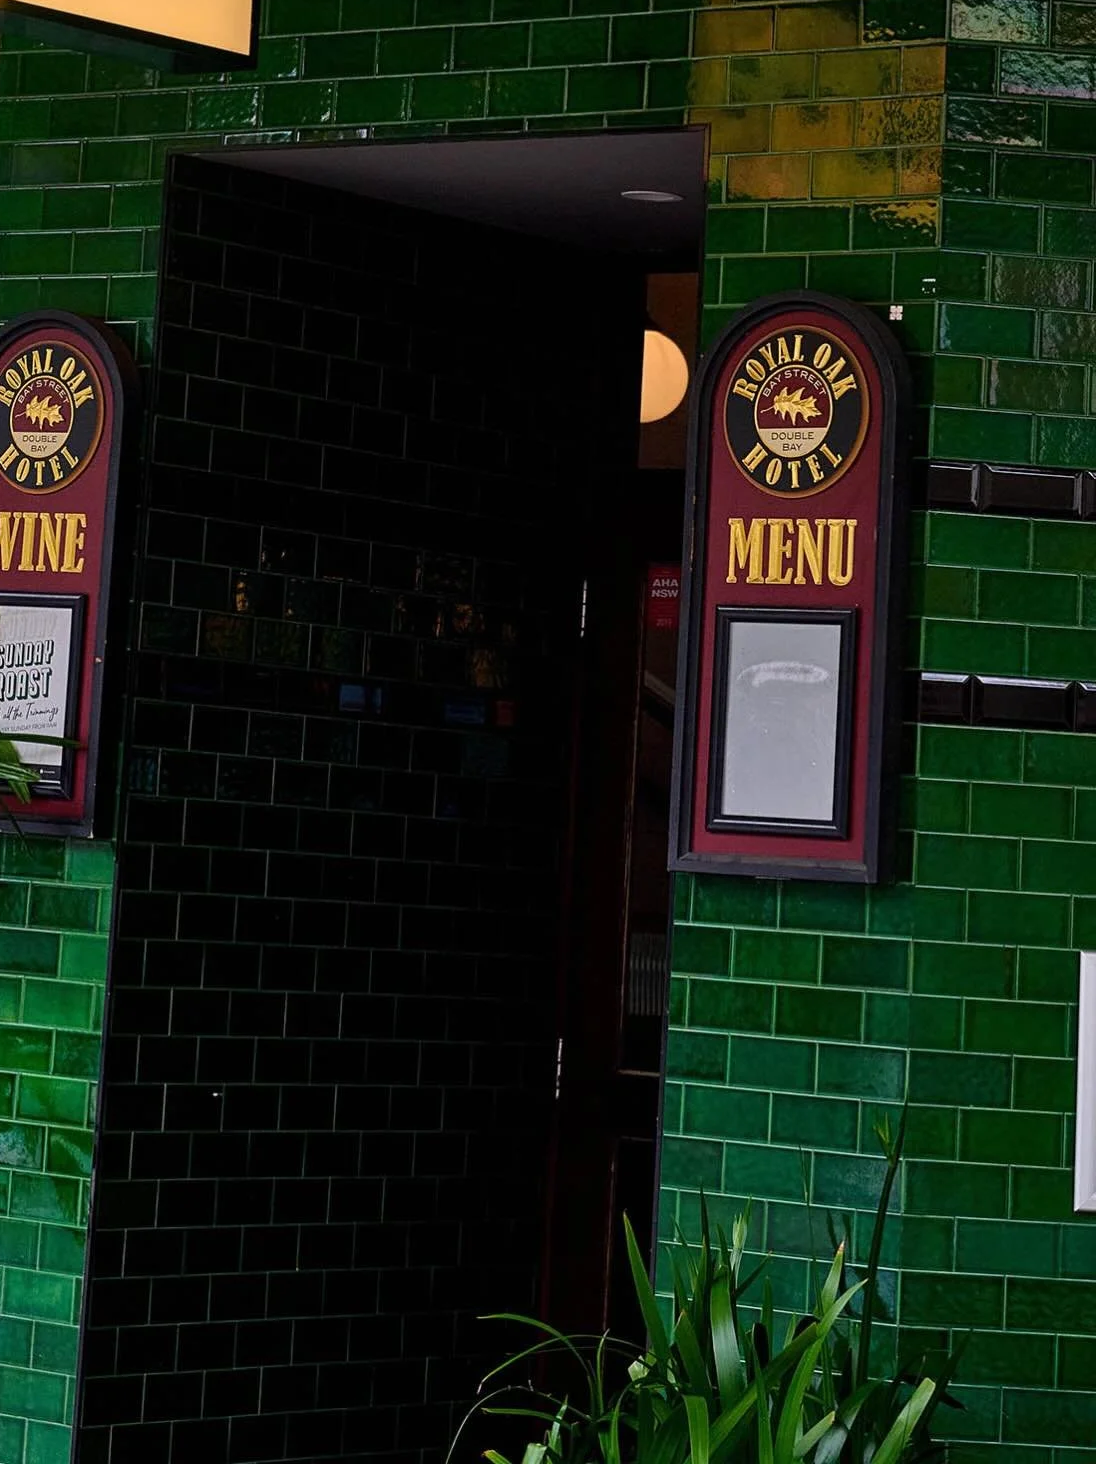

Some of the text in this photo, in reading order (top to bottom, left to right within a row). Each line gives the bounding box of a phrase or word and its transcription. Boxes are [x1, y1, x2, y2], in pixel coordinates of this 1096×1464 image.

[733, 334, 858, 402] ROYAL OAK
[58, 356, 96, 409] OAK
[762, 368, 827, 398] BAY STREET
[17, 379, 70, 404] BAY STREET
[22, 434, 57, 443] DOUBLE
[770, 431, 815, 441] DOUBLE
[30, 444, 48, 452] BAY
[782, 443, 803, 452] BAY
[741, 442, 844, 489] HOTEL
[726, 517, 858, 587] MENU
[652, 578, 679, 587] AHA
[651, 589, 679, 598] NSW
